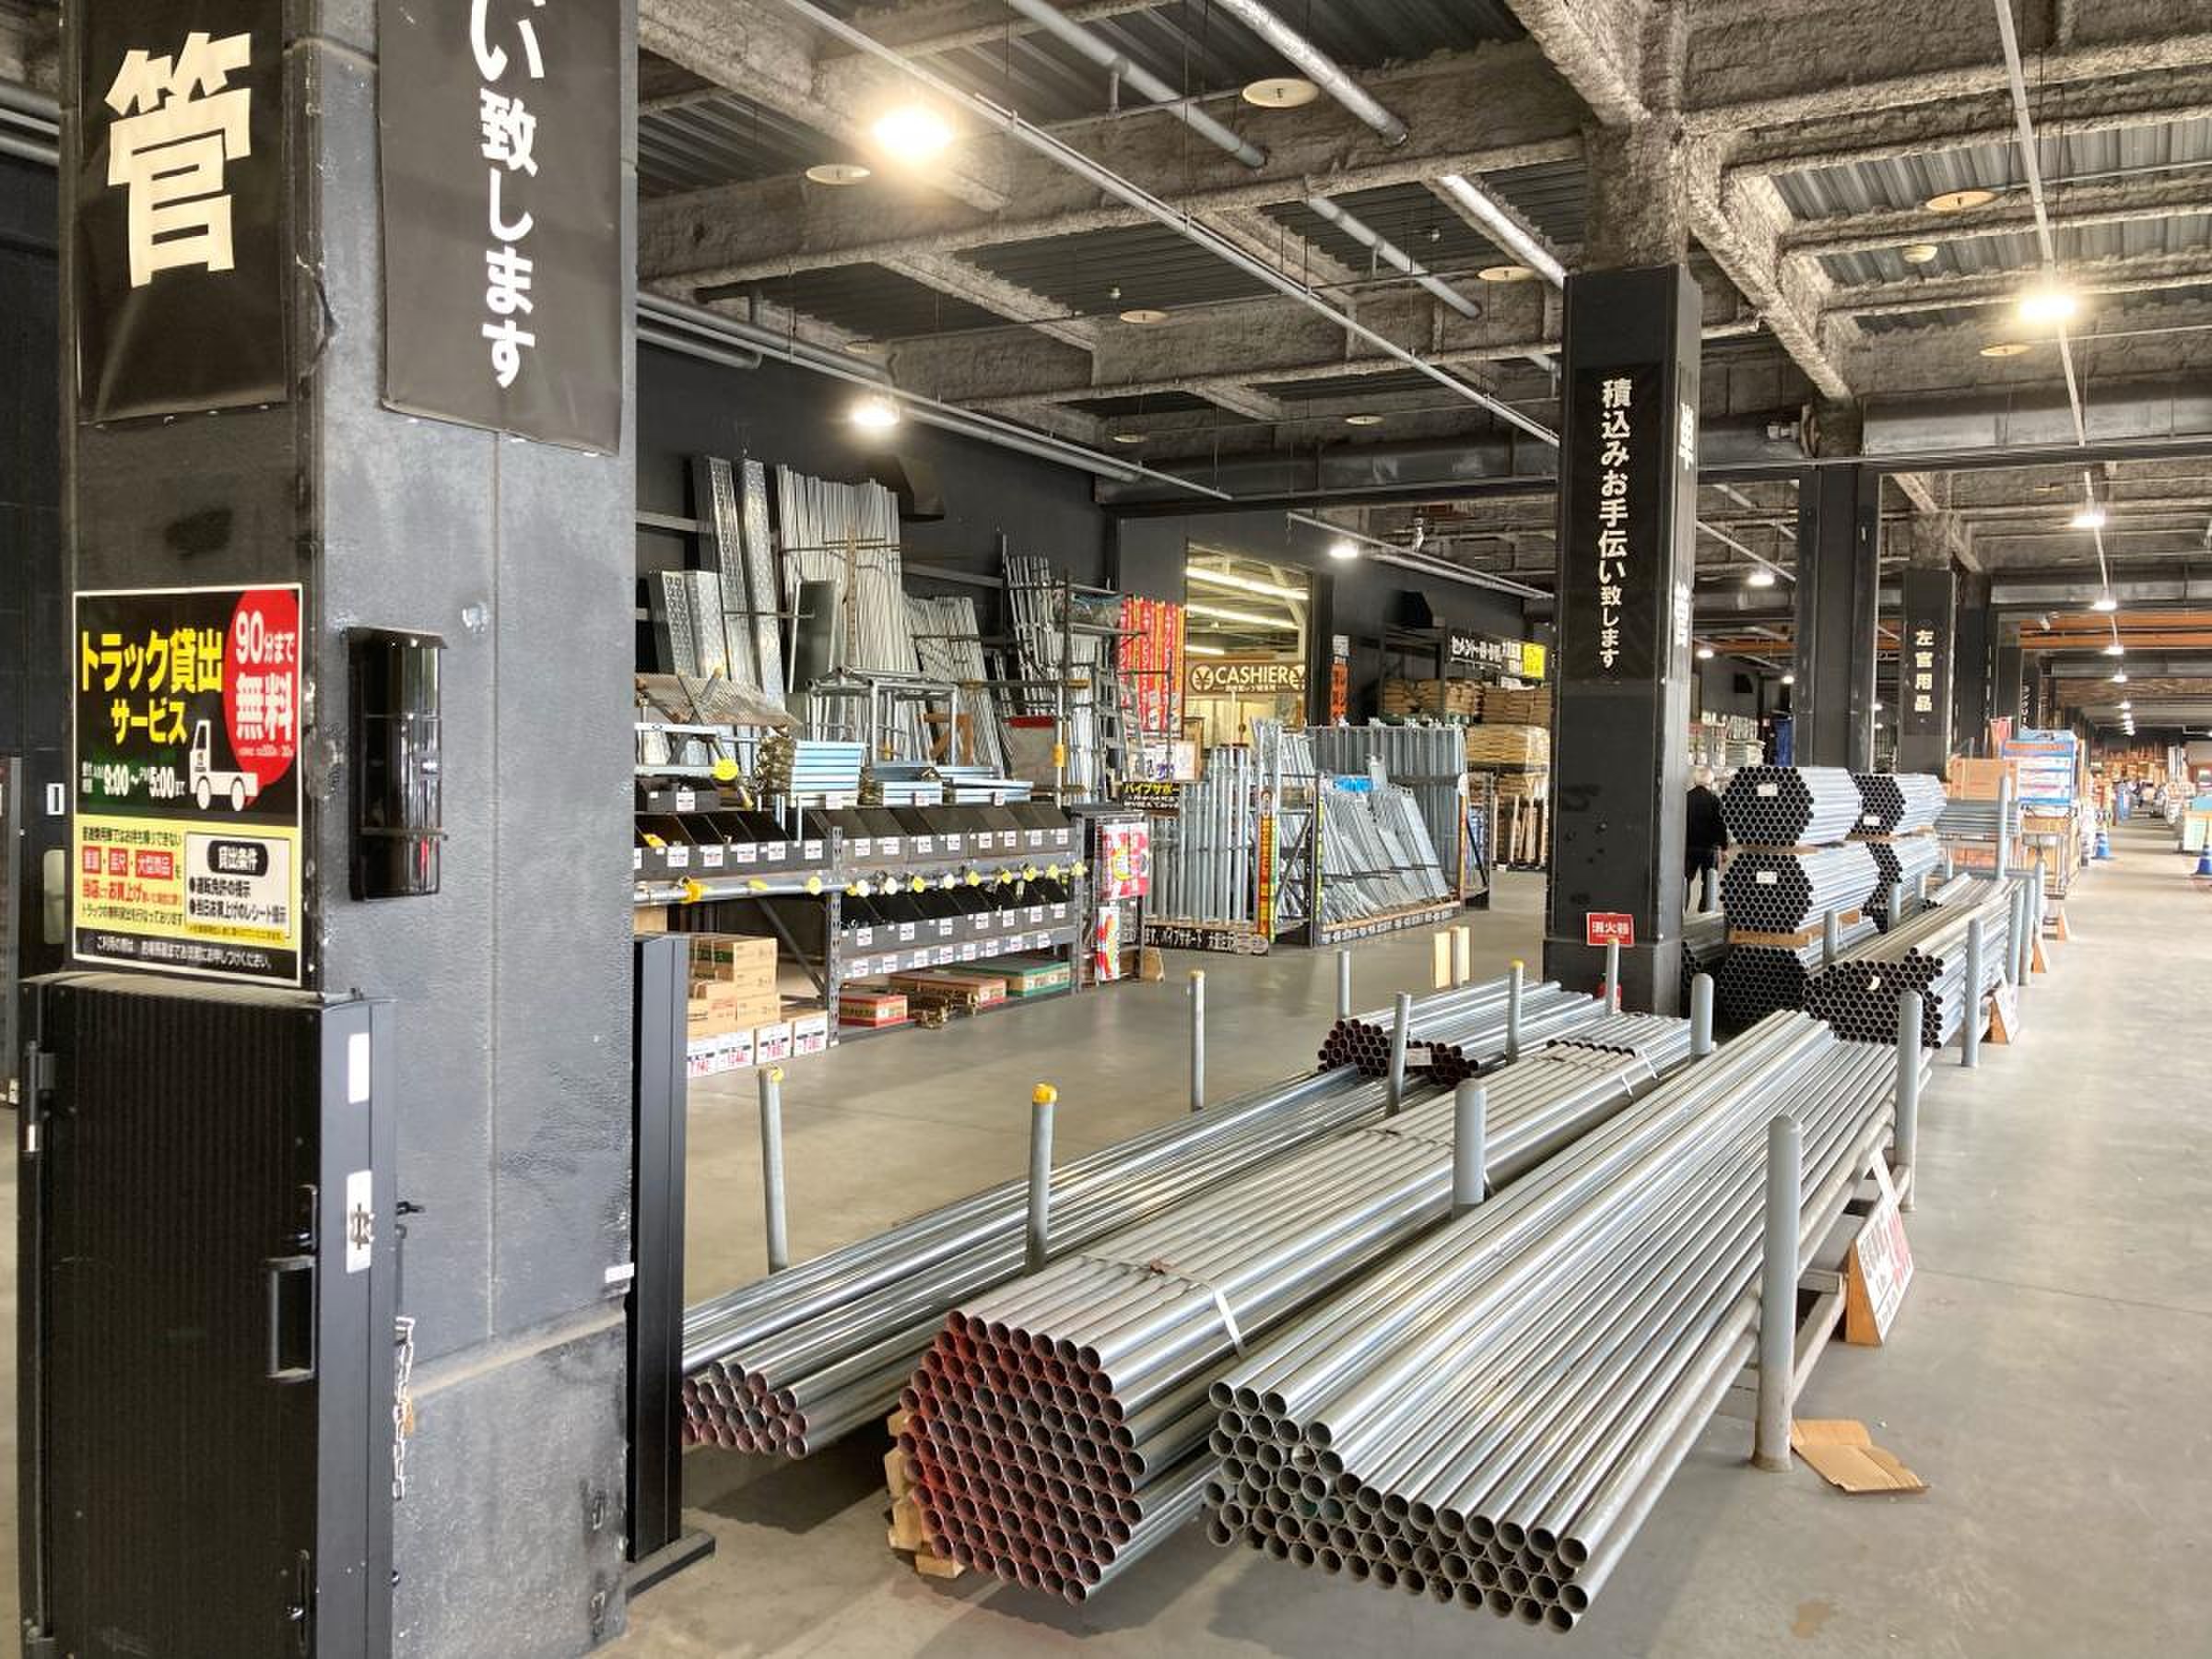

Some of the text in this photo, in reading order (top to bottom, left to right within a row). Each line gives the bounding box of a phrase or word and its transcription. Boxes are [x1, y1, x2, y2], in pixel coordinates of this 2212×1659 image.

[105, 31, 252, 288] 管
[469, 0, 546, 388] い致します
[1597, 377, 1633, 668] 積込みお手伝い致します
[81, 627, 223, 693] トラック貸出
[235, 610, 295, 664] 90分まで
[235, 671, 293, 741] 無料
[1215, 665, 1289, 685] CASHIER
[111, 697, 187, 746] サービス
